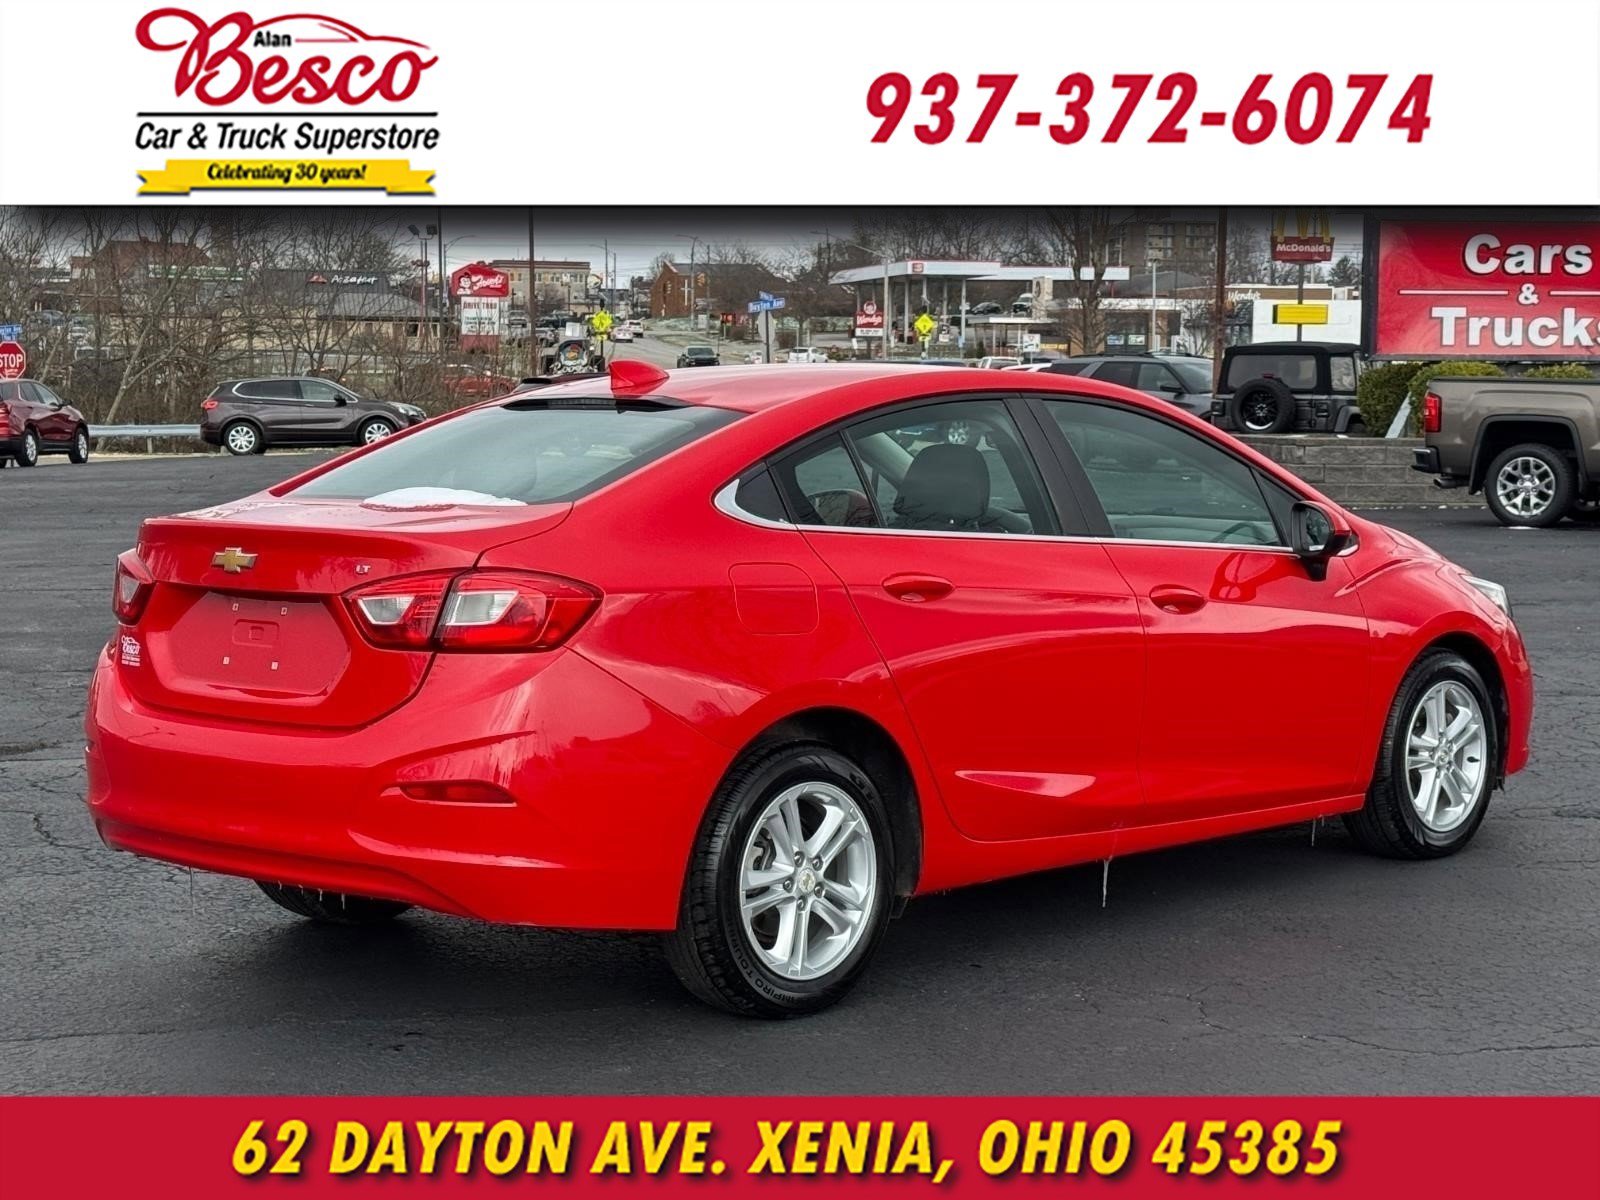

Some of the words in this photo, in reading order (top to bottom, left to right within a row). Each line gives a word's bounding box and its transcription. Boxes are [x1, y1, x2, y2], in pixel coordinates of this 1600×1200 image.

[1275, 242, 1332, 253] McDonald's
[1464, 233, 1594, 276] Cars
[1227, 289, 1262, 303] Wendy's
[1518, 282, 1540, 306] &
[1431, 306, 1600, 346] Truck
[356, 564, 371, 574] LT
